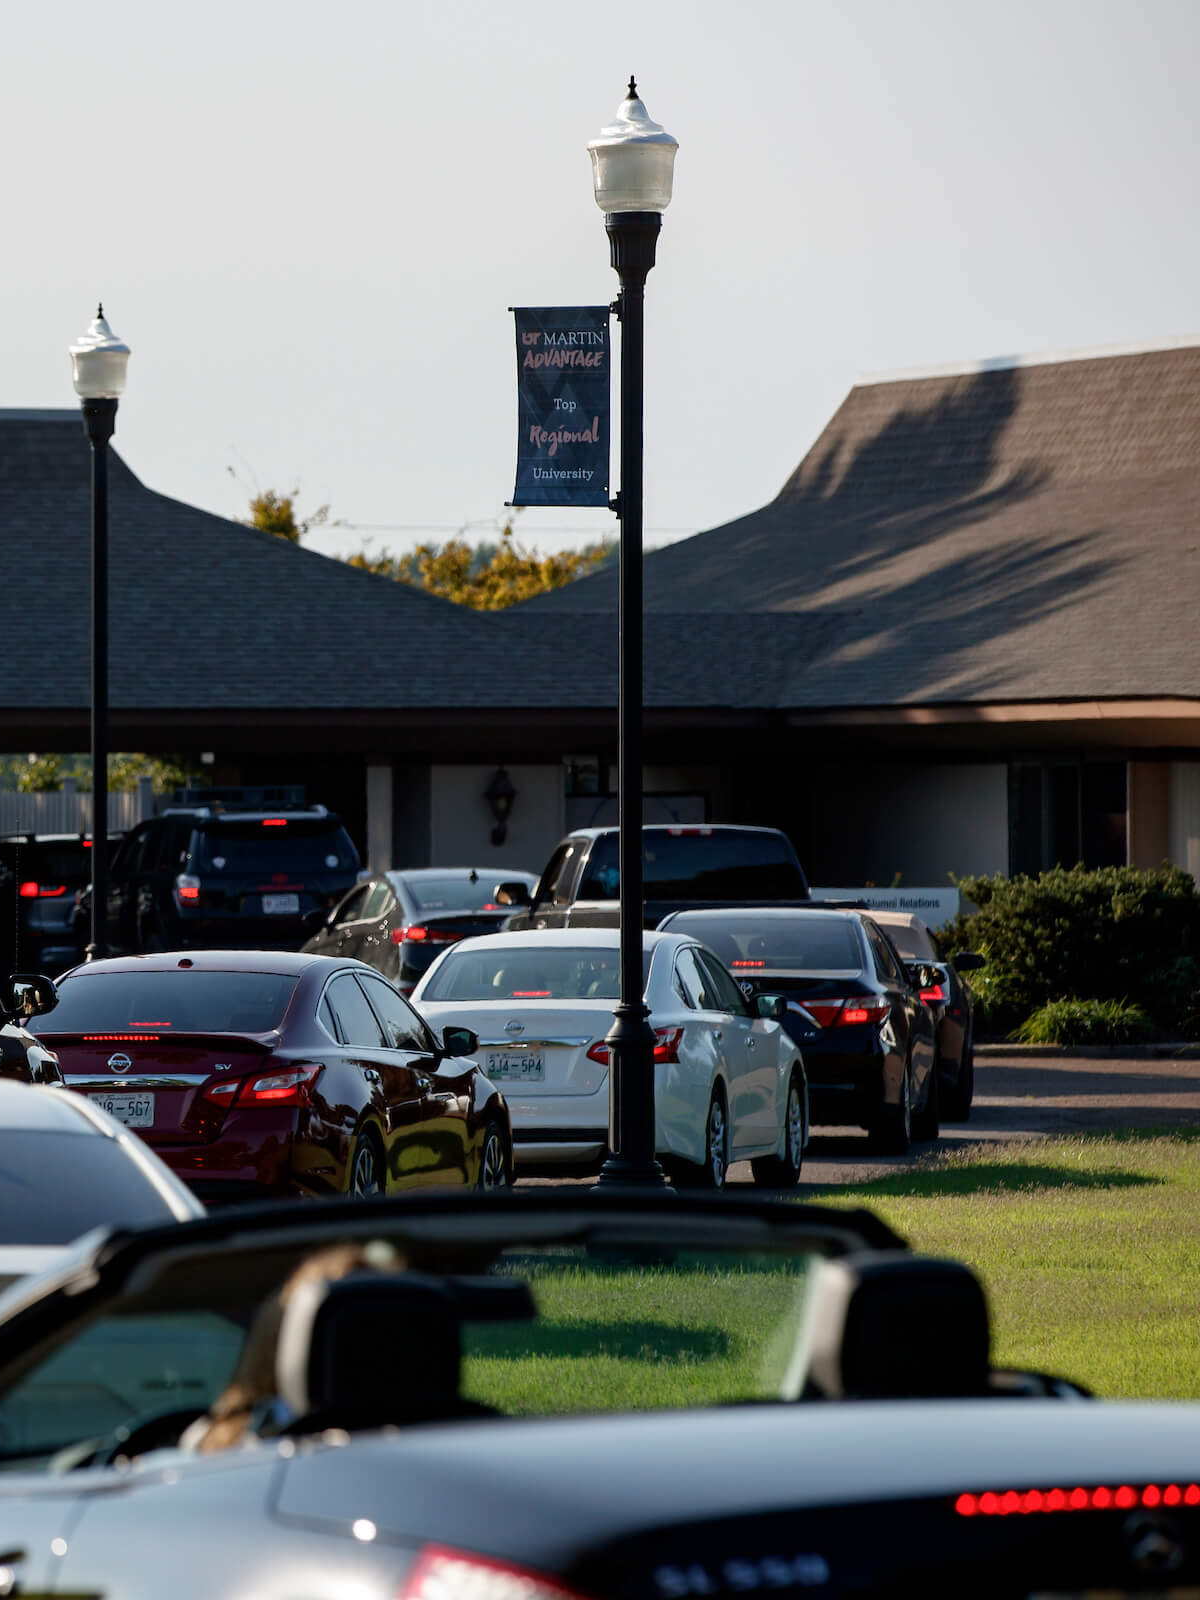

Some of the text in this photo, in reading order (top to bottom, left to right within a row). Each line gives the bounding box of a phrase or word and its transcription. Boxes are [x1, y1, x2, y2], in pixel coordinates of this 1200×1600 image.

[521, 331, 605, 345] UT MARTIN
[522, 348, 605, 368] ADVANTAGE
[553, 398, 577, 412] Top
[529, 415, 600, 456] Regional
[533, 467, 594, 480] University
